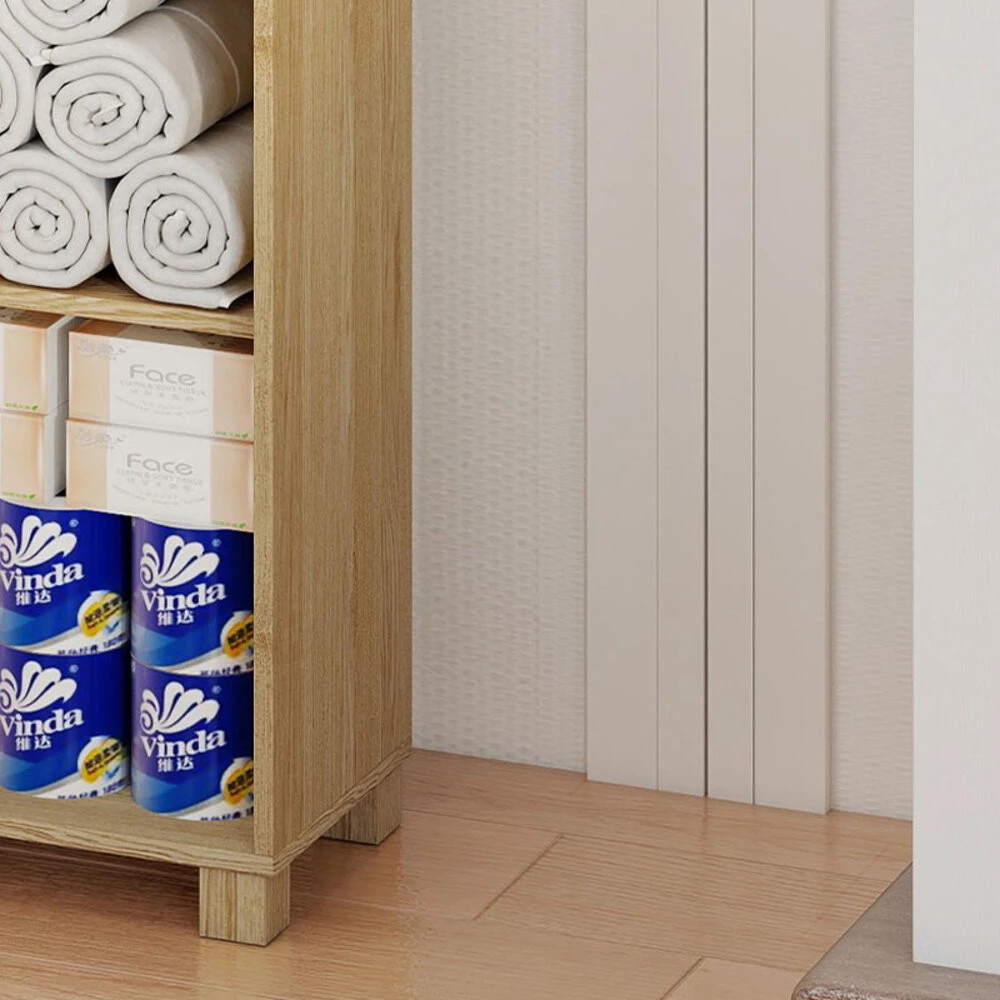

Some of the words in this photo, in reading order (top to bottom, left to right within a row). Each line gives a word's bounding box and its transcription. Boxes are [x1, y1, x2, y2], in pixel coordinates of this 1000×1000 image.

[129, 364, 196, 386] Face
[127, 453, 193, 476] Face
[0, 563, 84, 591] Vinda
[15, 589, 52, 606] 维达
[141, 583, 227, 611] Vinda
[157, 609, 194, 626] 维达
[0, 708, 84, 736] Vinda
[15, 735, 52, 751] 维达
[141, 729, 227, 758] Vinda
[157, 756, 194, 773] 维达
